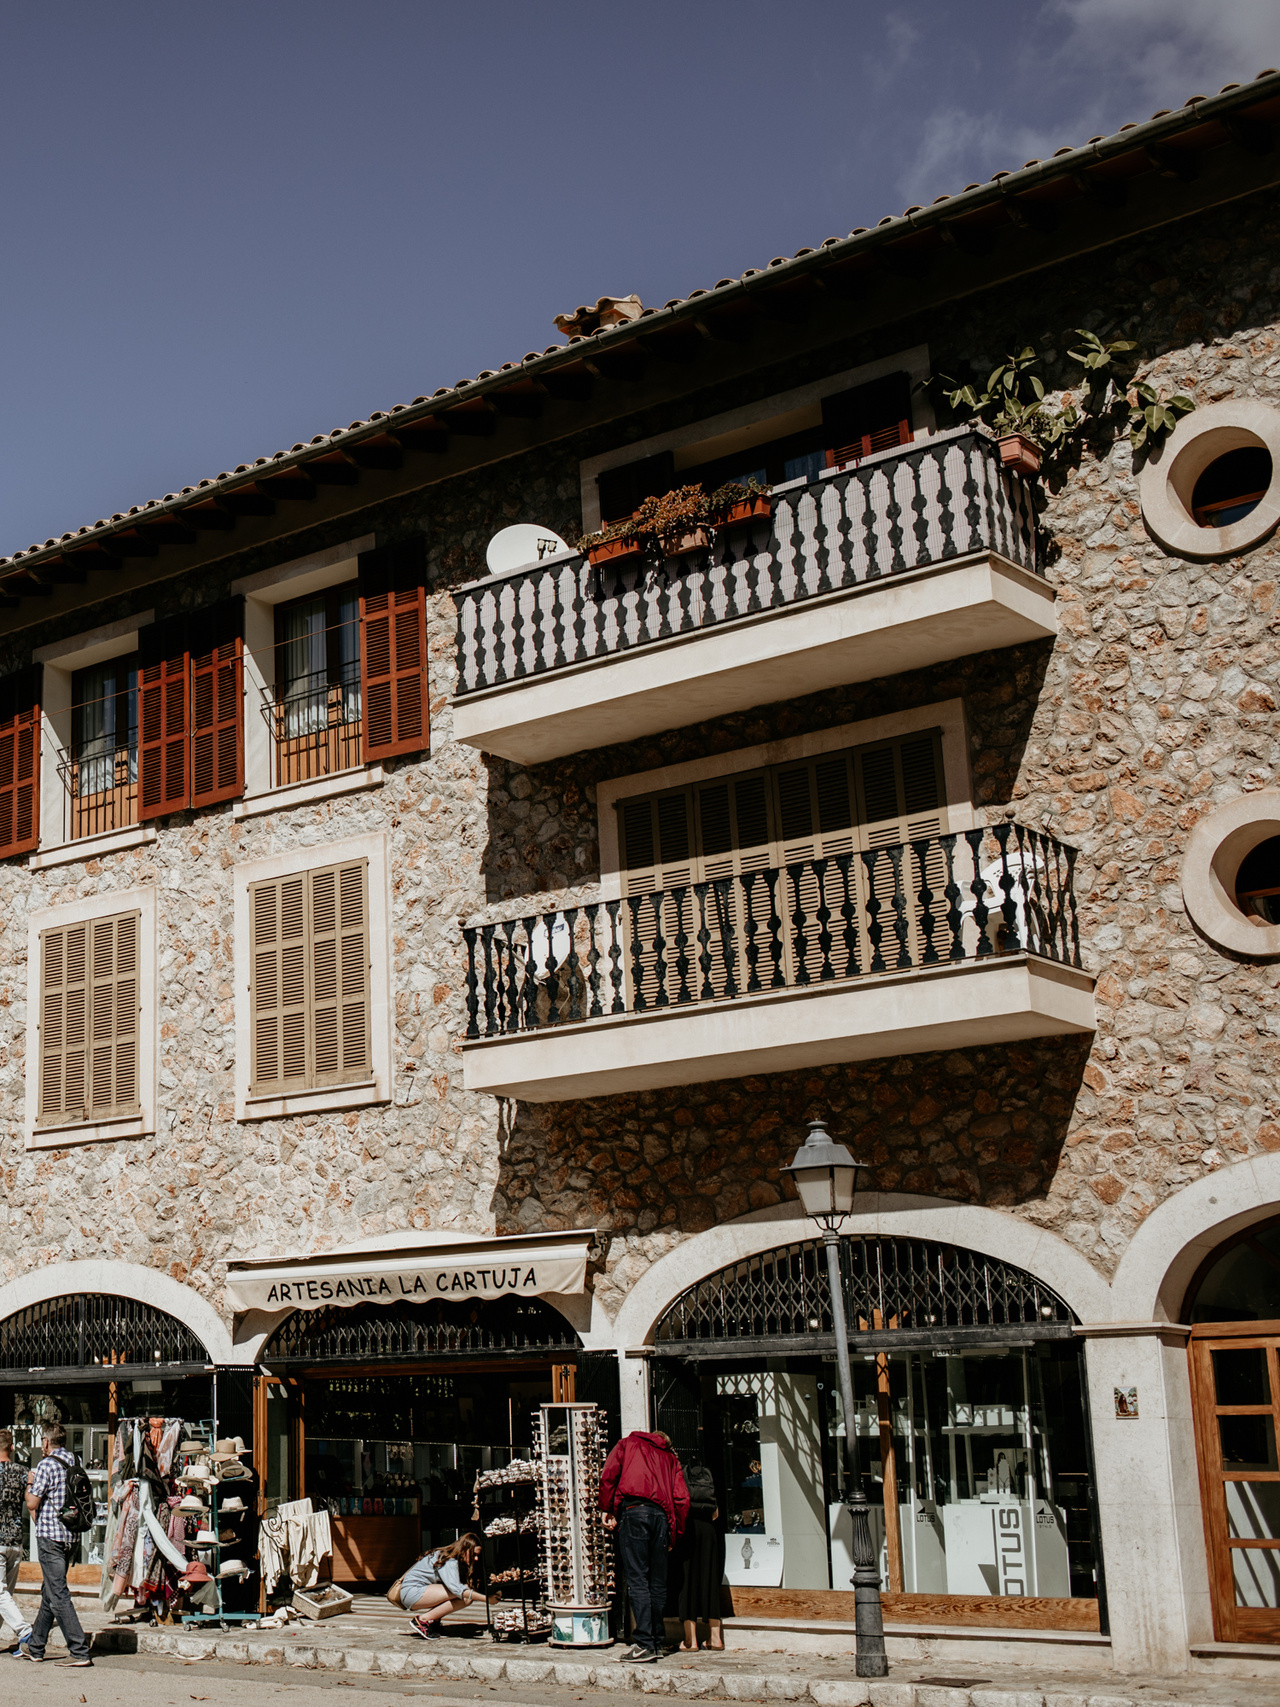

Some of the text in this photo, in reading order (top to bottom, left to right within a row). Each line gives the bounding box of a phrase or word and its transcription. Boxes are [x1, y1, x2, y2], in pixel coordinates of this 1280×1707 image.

[267, 1267, 537, 1303] ARTESANIA LA CARTUJA
[916, 1514, 935, 1523] LOTUS
[1035, 1515, 1055, 1524] LOTUS
[998, 1508, 1025, 1597] OTUS
